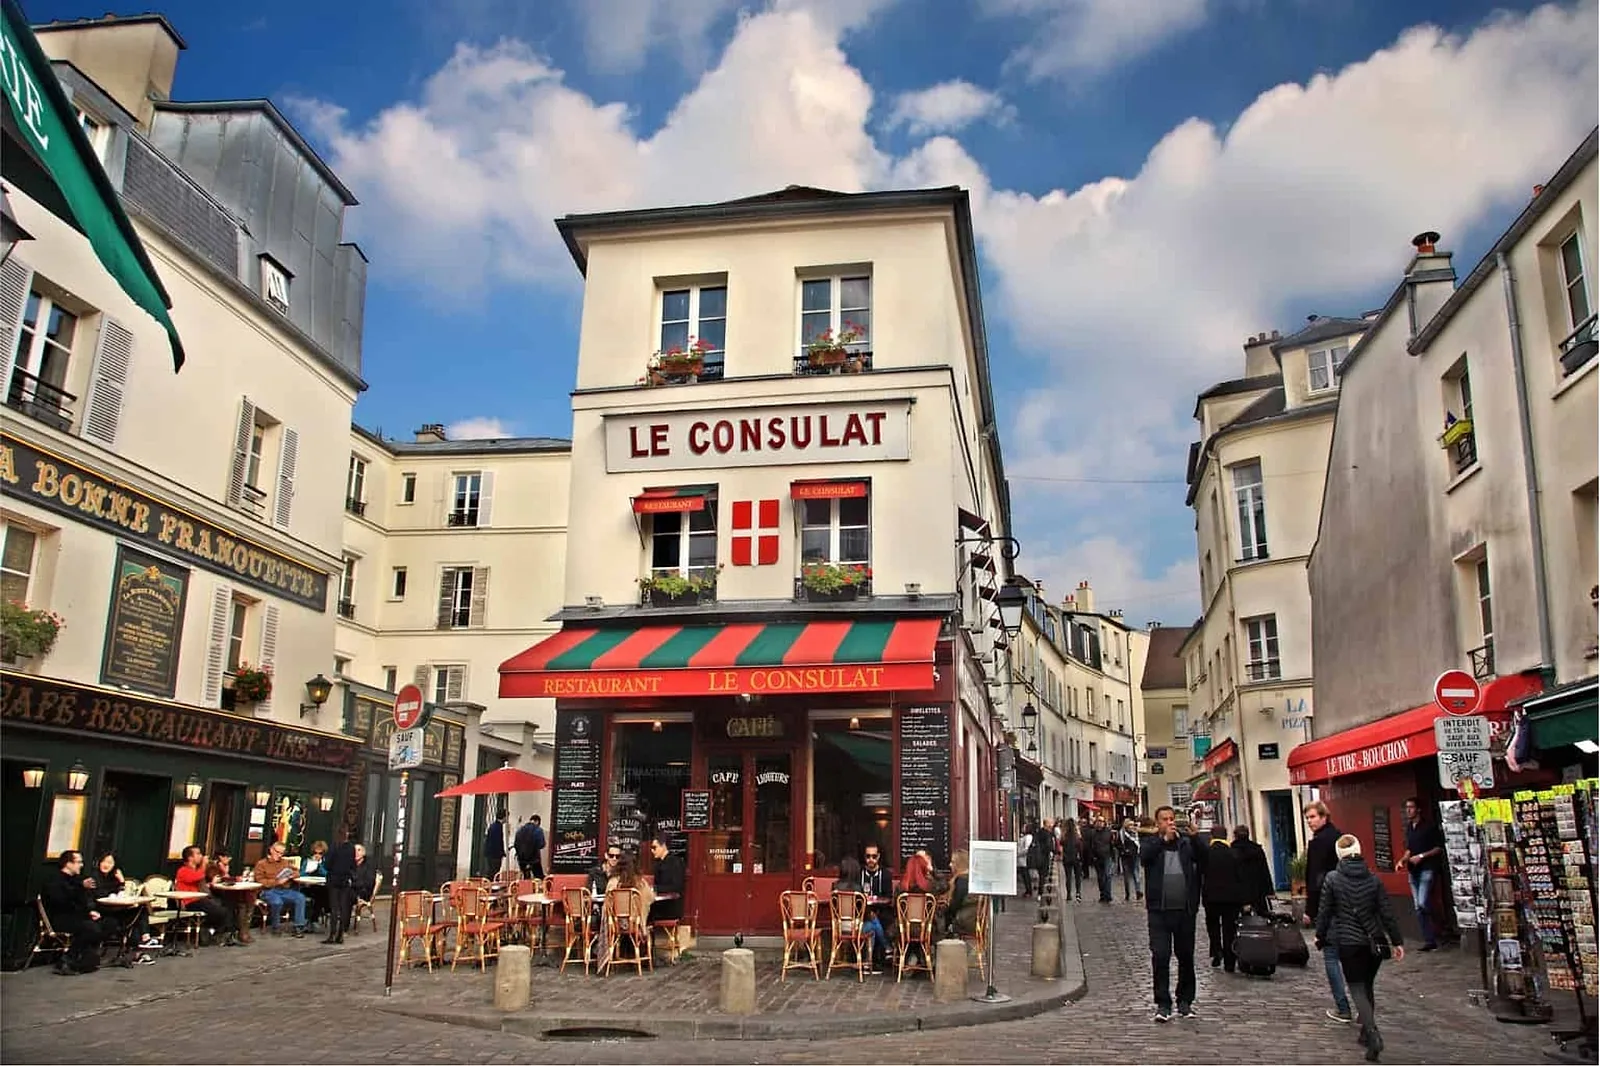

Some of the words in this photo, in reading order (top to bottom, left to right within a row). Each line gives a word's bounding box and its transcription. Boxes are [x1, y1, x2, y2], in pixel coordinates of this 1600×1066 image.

[629, 424, 670, 458] LE
[688, 411, 887, 455] CONSULAT
[32, 460, 150, 533] BONNE
[543, 675, 662, 697] RESTAURANT
[708, 671, 740, 694] LE
[749, 667, 885, 692] CONSULAT
[1286, 699, 1306, 712] LA
[86, 697, 260, 753] RESTAURANT
[1443, 719, 1480, 727] INTERDIT
[396, 731, 414, 744] SAUF
[1326, 757, 1337, 775] LE
[1451, 753, 1481, 763] SAUF
[755, 771, 790, 785] LIQUEURS
